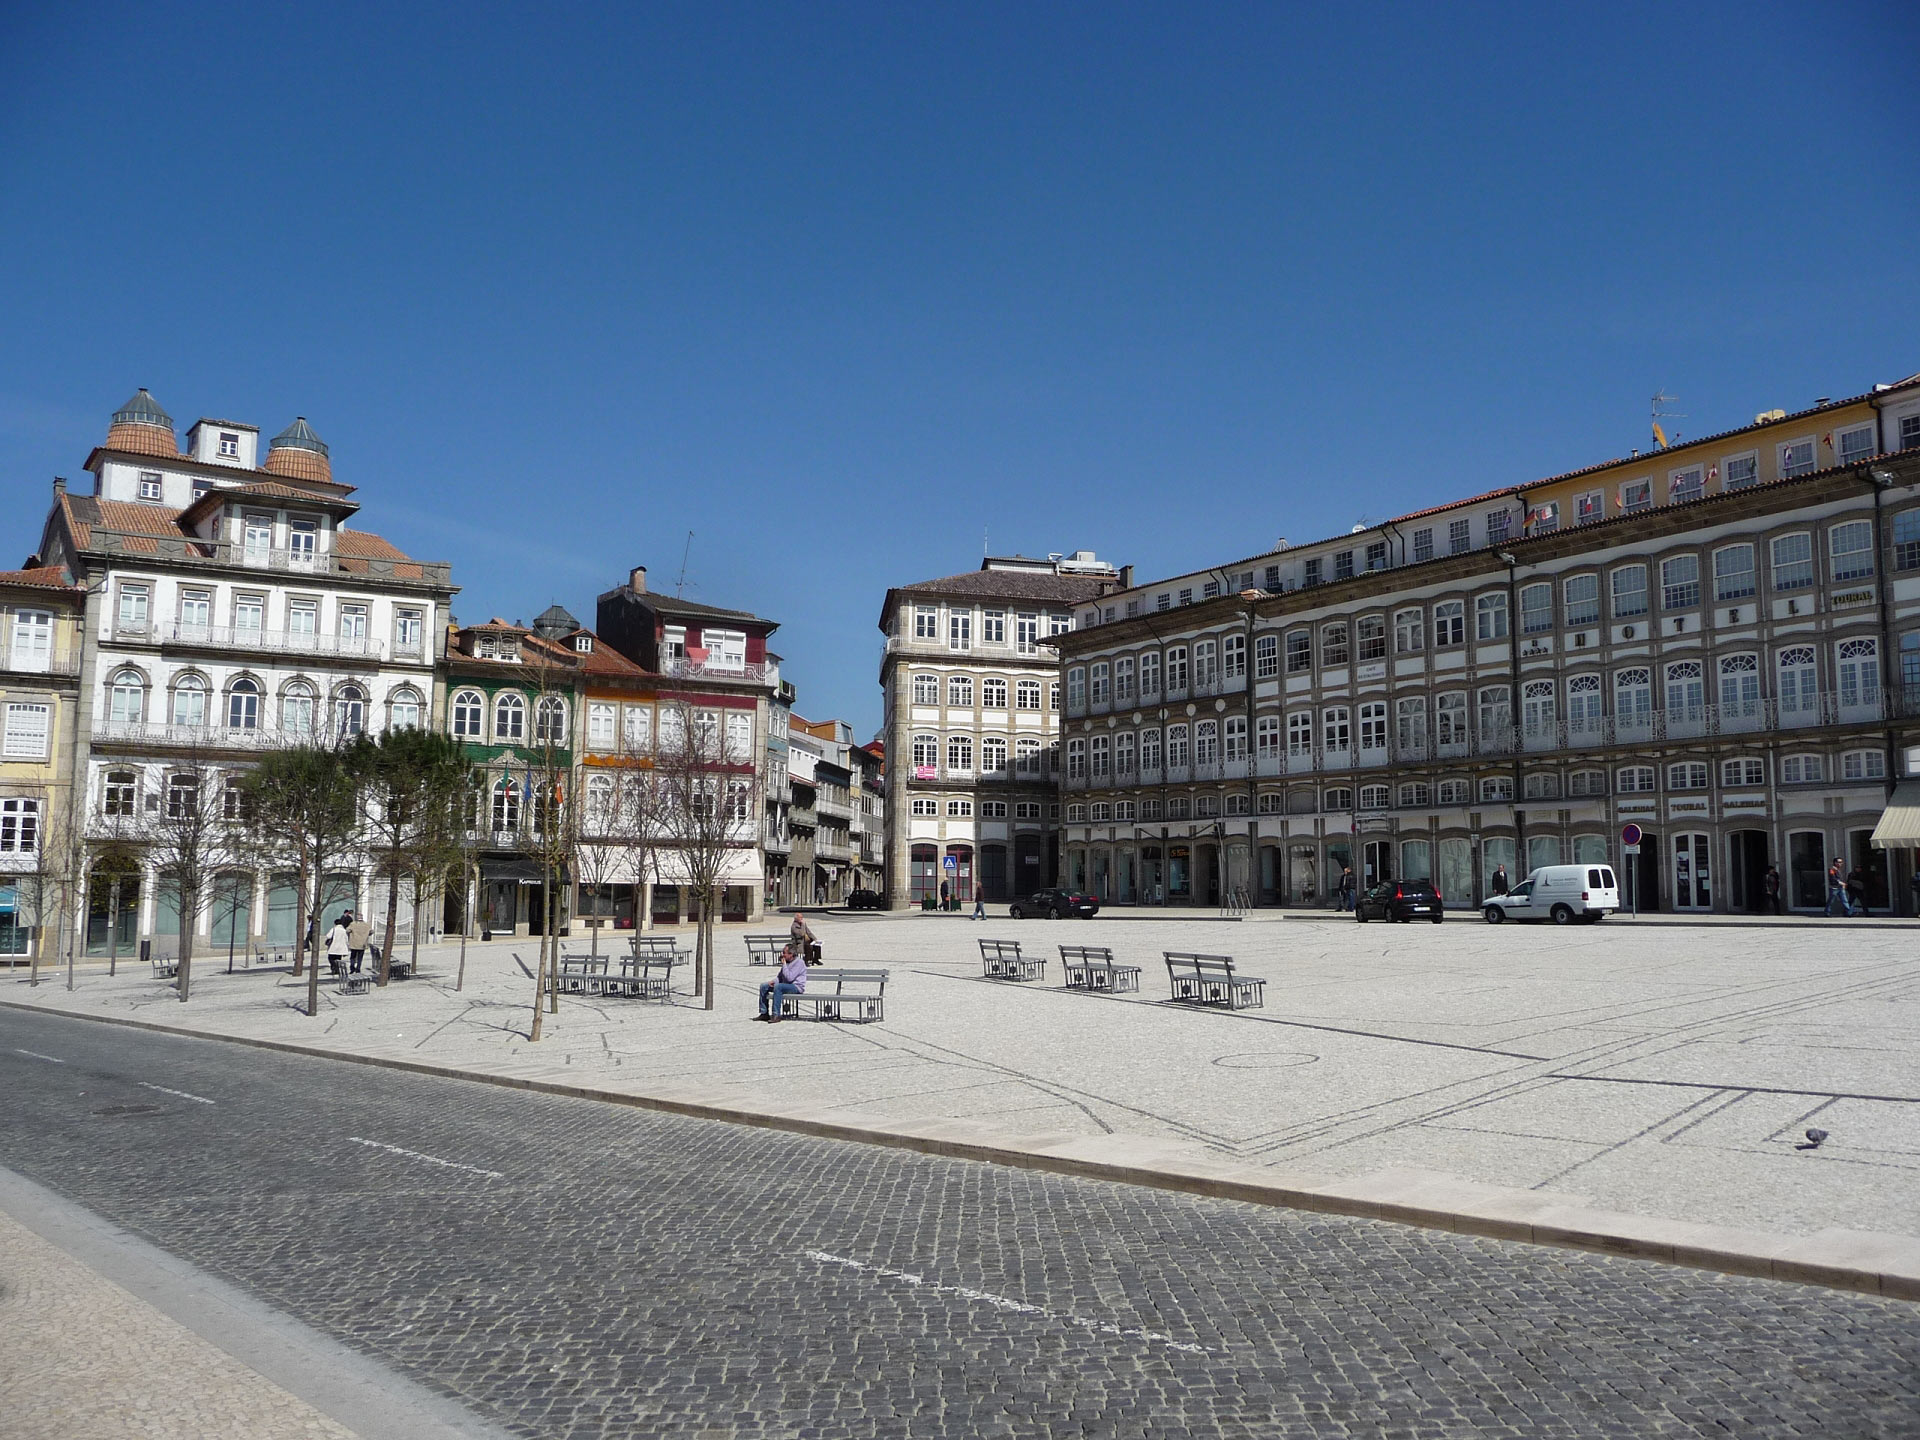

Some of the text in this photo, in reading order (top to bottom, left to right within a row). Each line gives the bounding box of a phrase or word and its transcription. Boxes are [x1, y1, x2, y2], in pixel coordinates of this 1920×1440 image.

[1831, 591, 1873, 605] TOURAL
[1670, 803, 1707, 812] TOURAL
[1723, 800, 1765, 808] GALERIAS
[1617, 805, 1655, 813] GALERIAS
